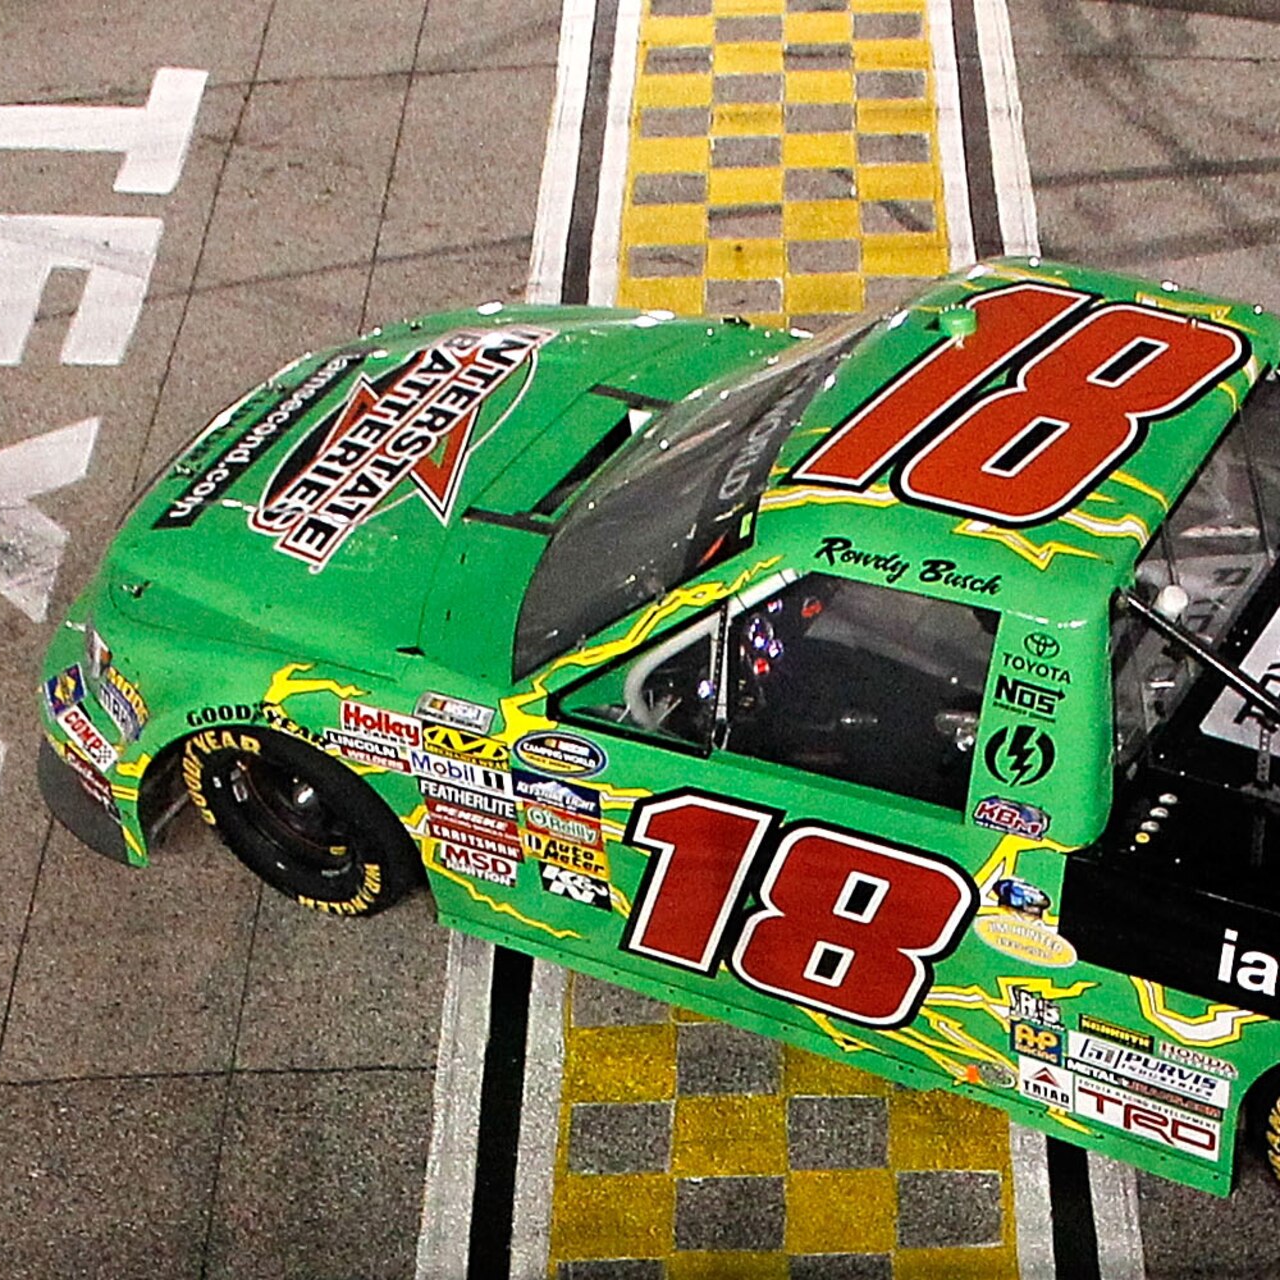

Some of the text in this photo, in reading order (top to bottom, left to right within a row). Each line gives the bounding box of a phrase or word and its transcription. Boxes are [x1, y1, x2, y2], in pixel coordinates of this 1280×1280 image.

[788, 282, 1250, 526] 18
[261, 331, 477, 533] BATTERIES
[291, 329, 542, 555] INTERSTATE
[814, 537, 1002, 595] Rowdy Busch
[1002, 652, 1072, 684] TOYOTA
[994, 674, 1055, 715] NOS
[64, 710, 103, 752] COMP
[343, 703, 420, 746] Holley
[329, 732, 398, 759] LINCOLN
[182, 729, 262, 826] GOODYEAR
[411, 750, 476, 784] Mobil
[420, 779, 517, 819] FEATHERLITE
[444, 845, 513, 877] MSD
[547, 839, 596, 861] Auto
[628, 794, 975, 1026] 18
[1125, 1052, 1217, 1089] PURVIS
[1161, 1043, 1237, 1076] HONDA
[1023, 1080, 1070, 1104] TRIAD
[1122, 1063, 1214, 1098] INDUSTRIES
[1078, 1086, 1216, 1151] TRD
